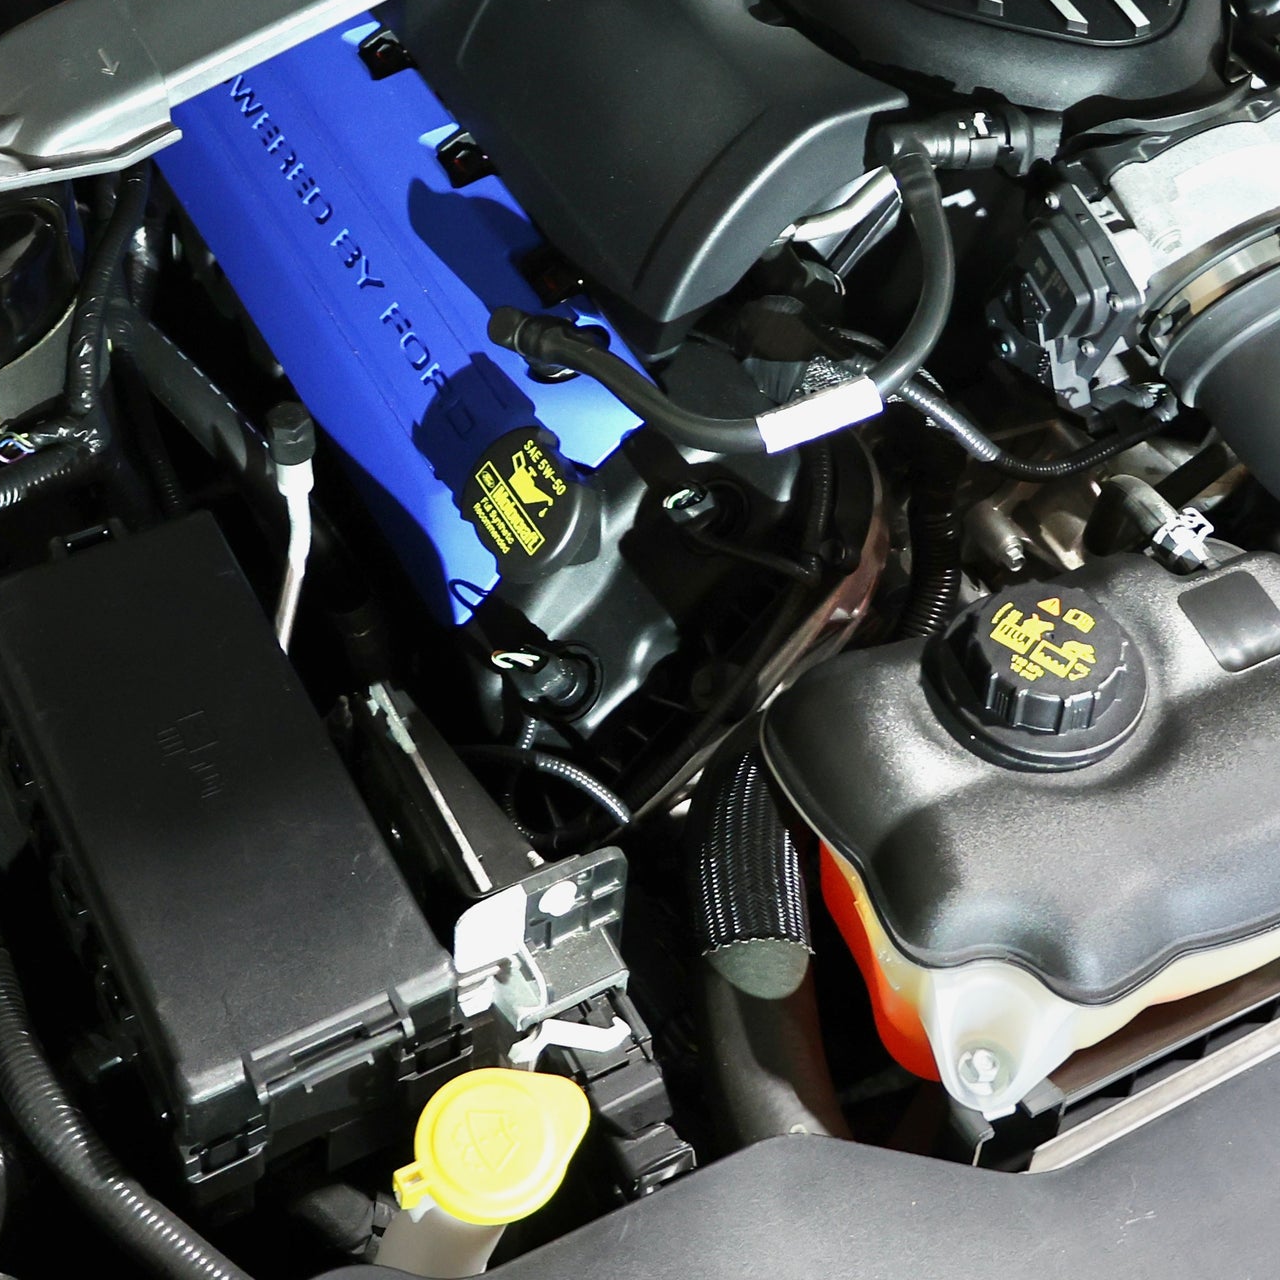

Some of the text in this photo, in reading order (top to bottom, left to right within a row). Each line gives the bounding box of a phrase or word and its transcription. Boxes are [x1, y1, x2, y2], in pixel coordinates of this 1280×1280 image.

[229, 74, 333, 226] WERED
[330, 228, 385, 290] BY
[523, 439, 567, 496] SAE 5W-50
[472, 502, 511, 554] Recommended
[488, 509, 515, 545] Synthetic
